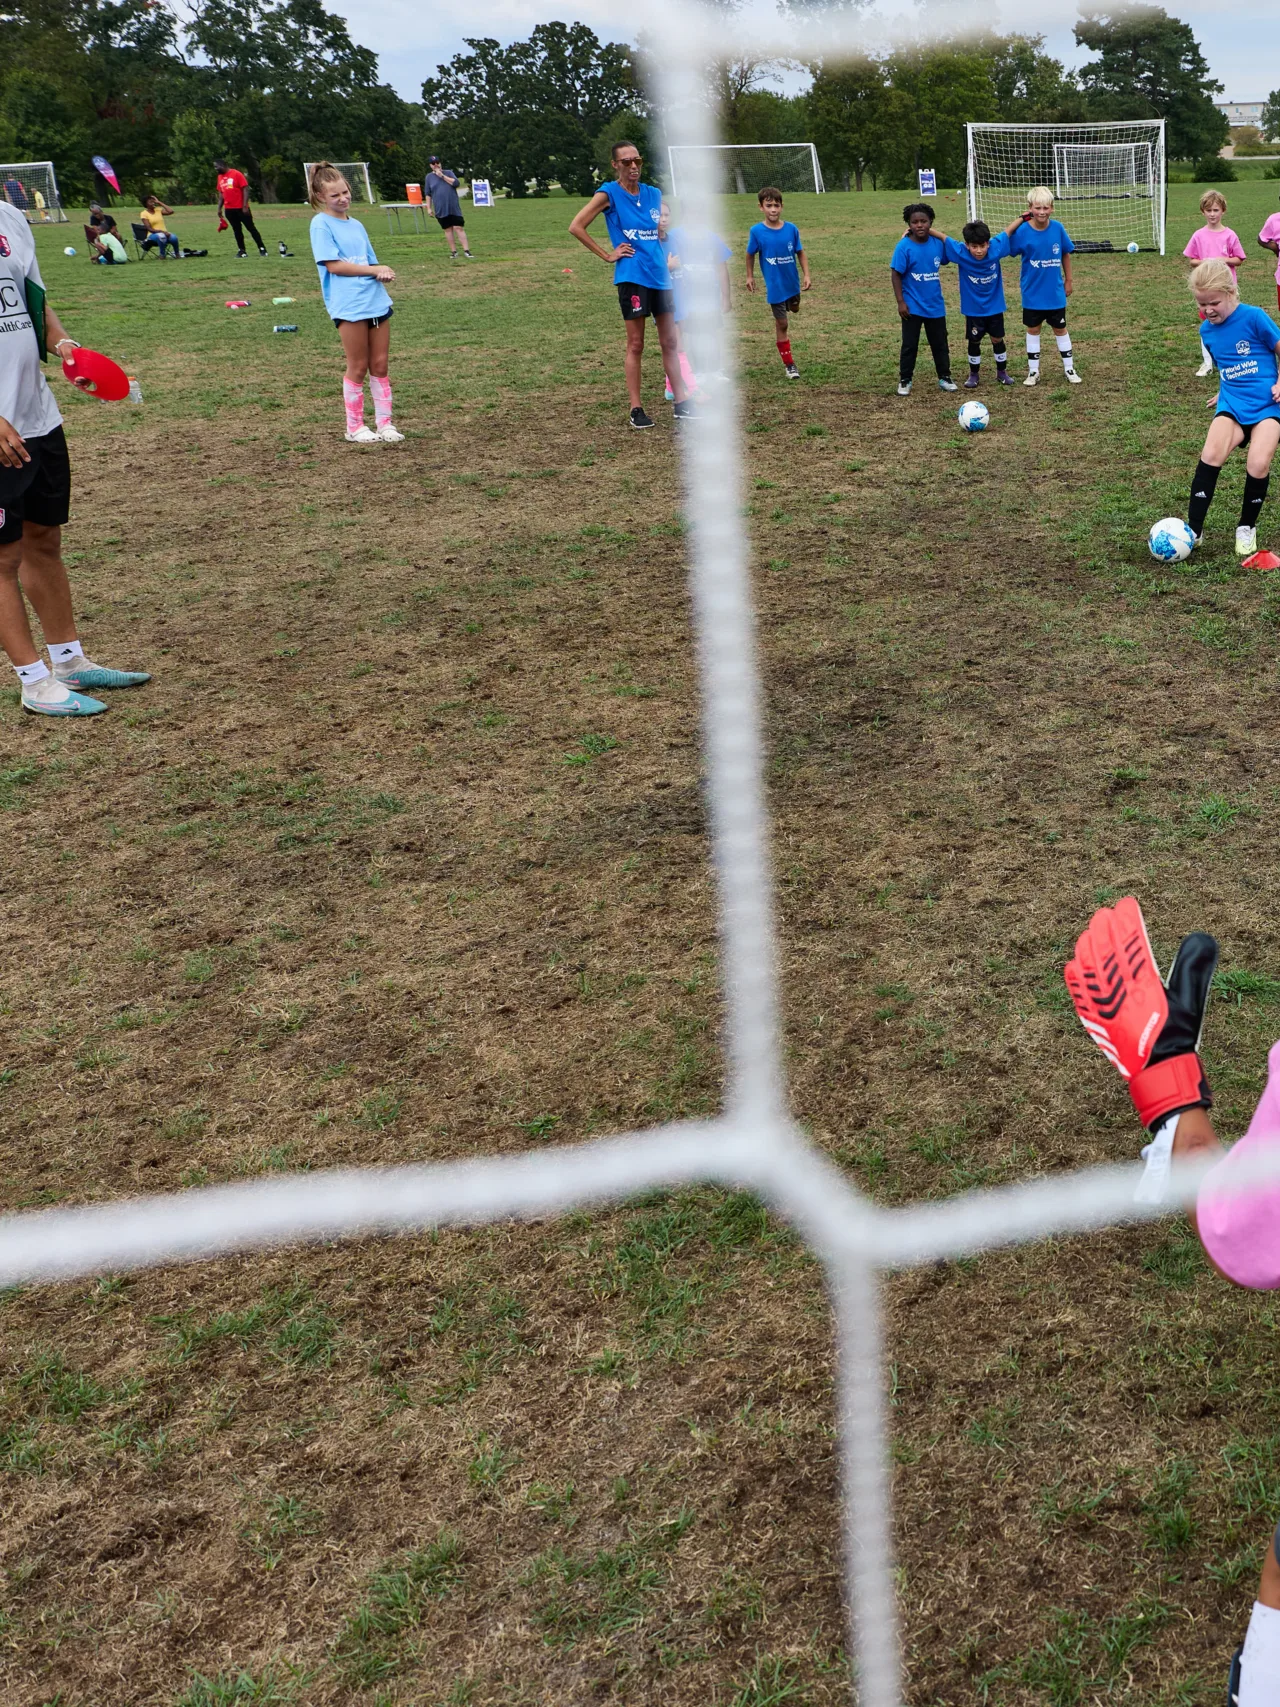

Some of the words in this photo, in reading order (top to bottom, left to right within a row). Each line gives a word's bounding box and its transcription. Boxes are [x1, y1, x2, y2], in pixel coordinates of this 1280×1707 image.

[0, 286, 18, 313] JC
[1225, 364, 1240, 374] World
[1240, 360, 1258, 369] Wide
[1226, 366, 1259, 380] Technology
[1137, 1011, 1160, 1058] PREDATOR
